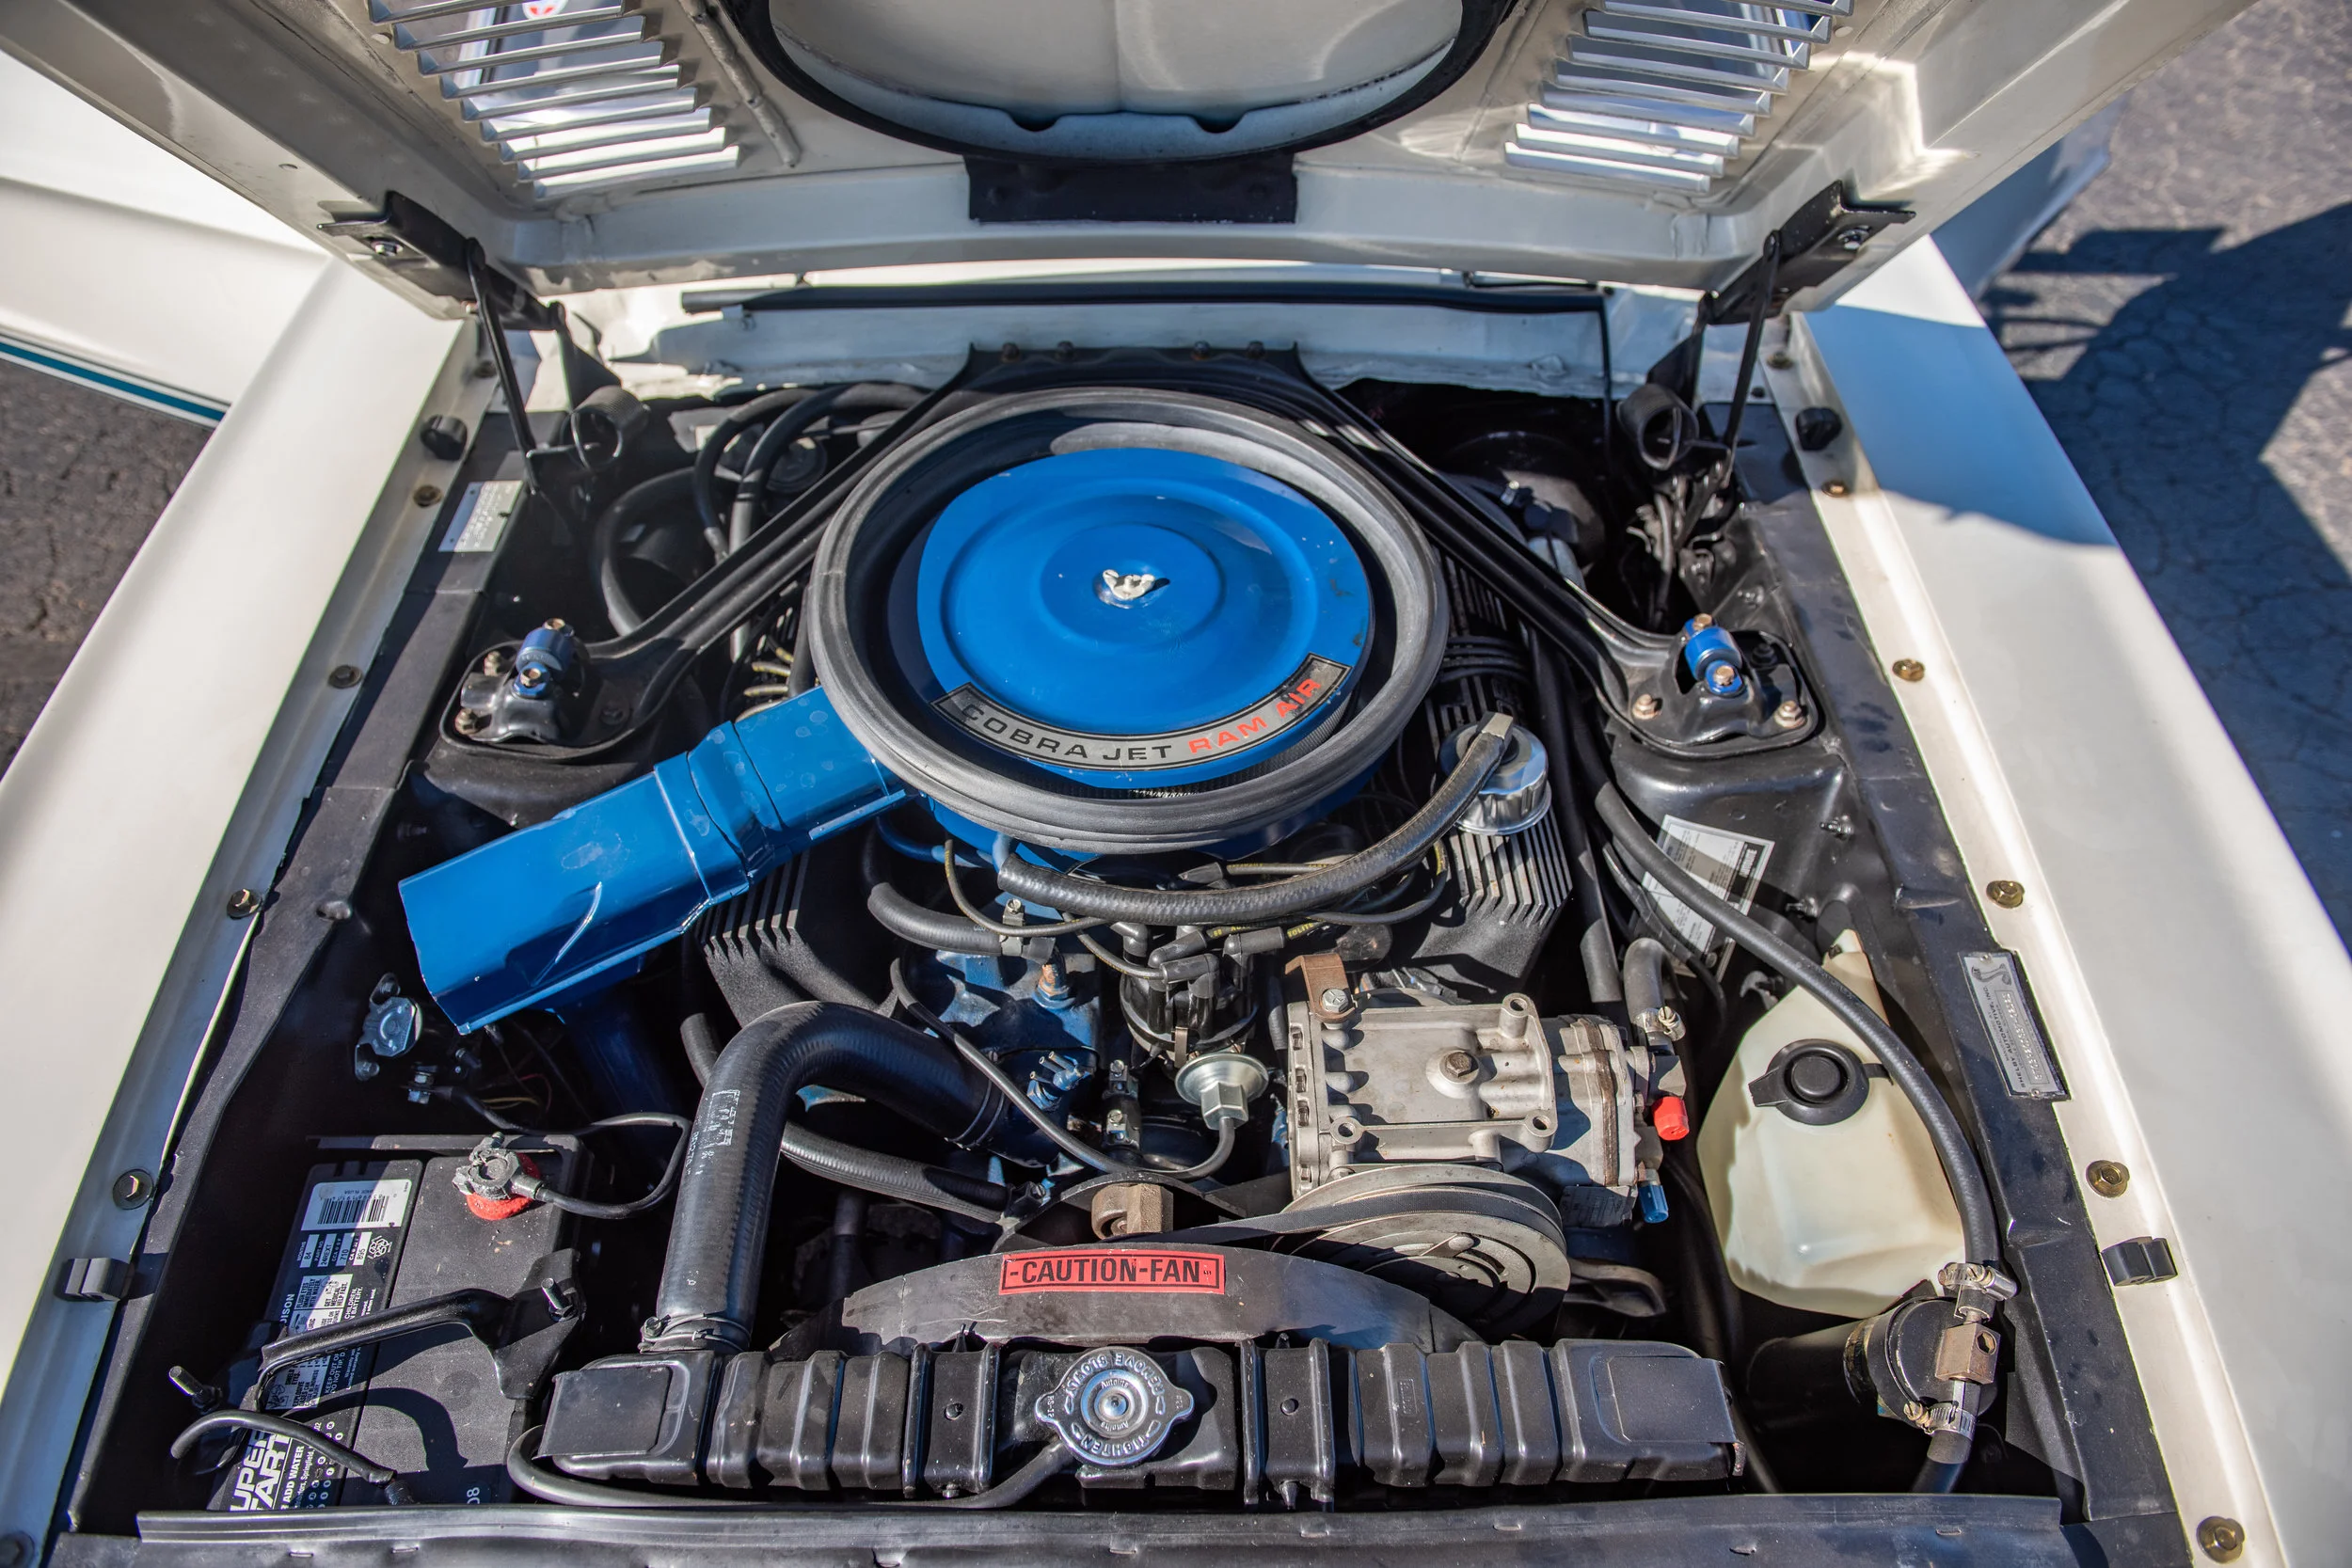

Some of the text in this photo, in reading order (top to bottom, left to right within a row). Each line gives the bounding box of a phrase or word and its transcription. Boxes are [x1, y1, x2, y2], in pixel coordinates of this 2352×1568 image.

[961, 677, 1322, 762] COBRA JET RAM AIR
[1982, 985, 1992, 1000] INC.
[2010, 1057, 2026, 1088] SHELBY
[340, 1248, 349, 1260] 710
[300, 1281, 309, 1292] EYES
[329, 1286, 341, 1307] MEDICAL
[335, 1294, 344, 1306] HELP
[342, 1286, 358, 1319] CHILDREN.
[350, 1286, 363, 1314] BATTERY.
[328, 1362, 338, 1376] OUT
[333, 1369, 342, 1384] NOT
[1065, 1353, 1165, 1398] REMOVE SLOWLY
[324, 1376, 334, 1394] KEEP
[330, 1383, 338, 1393] DO
[1080, 1434, 1149, 1457] TIGHTEN
[229, 1429, 267, 1511] UPER
[287, 1445, 304, 1480] WATER
[299, 1449, 315, 1480] Springfield,
[282, 1481, 294, 1502] ADD
